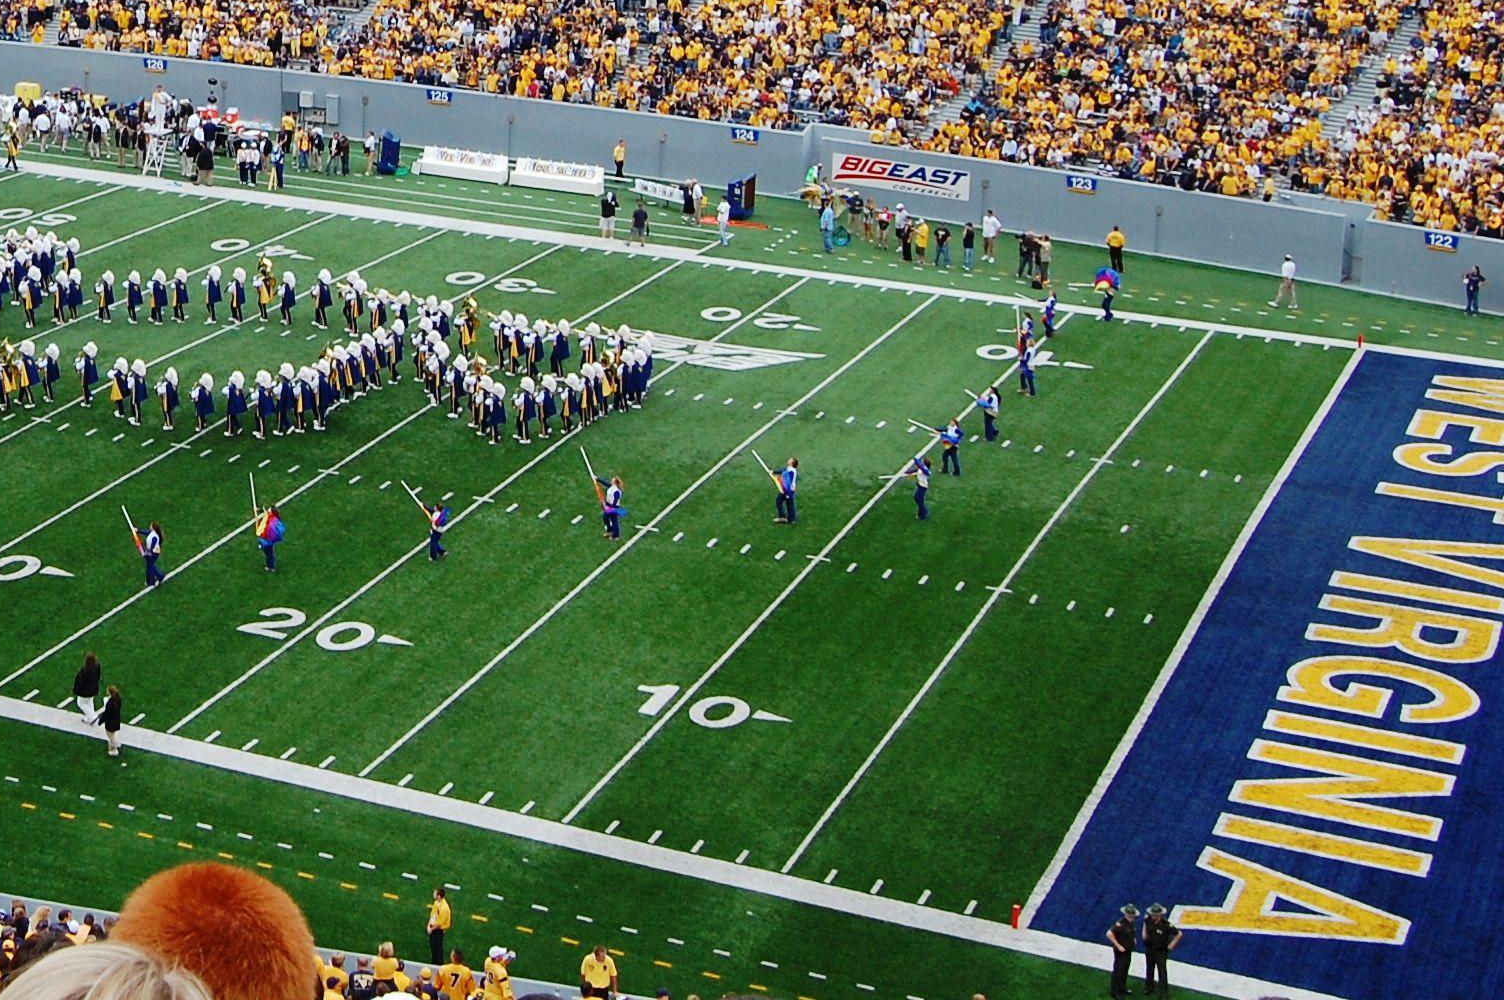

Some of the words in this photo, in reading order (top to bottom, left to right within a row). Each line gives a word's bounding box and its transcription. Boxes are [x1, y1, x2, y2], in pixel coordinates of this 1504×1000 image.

[734, 129, 754, 141] 124
[1071, 177, 1093, 190] 123
[893, 185, 962, 198] CONFERENCE
[1428, 233, 1453, 248] 122
[235, 607, 376, 651] 20
[636, 683, 751, 729] 10
[1171, 535, 1504, 946] VIRGINIA
[450, 973, 460, 988] 7
